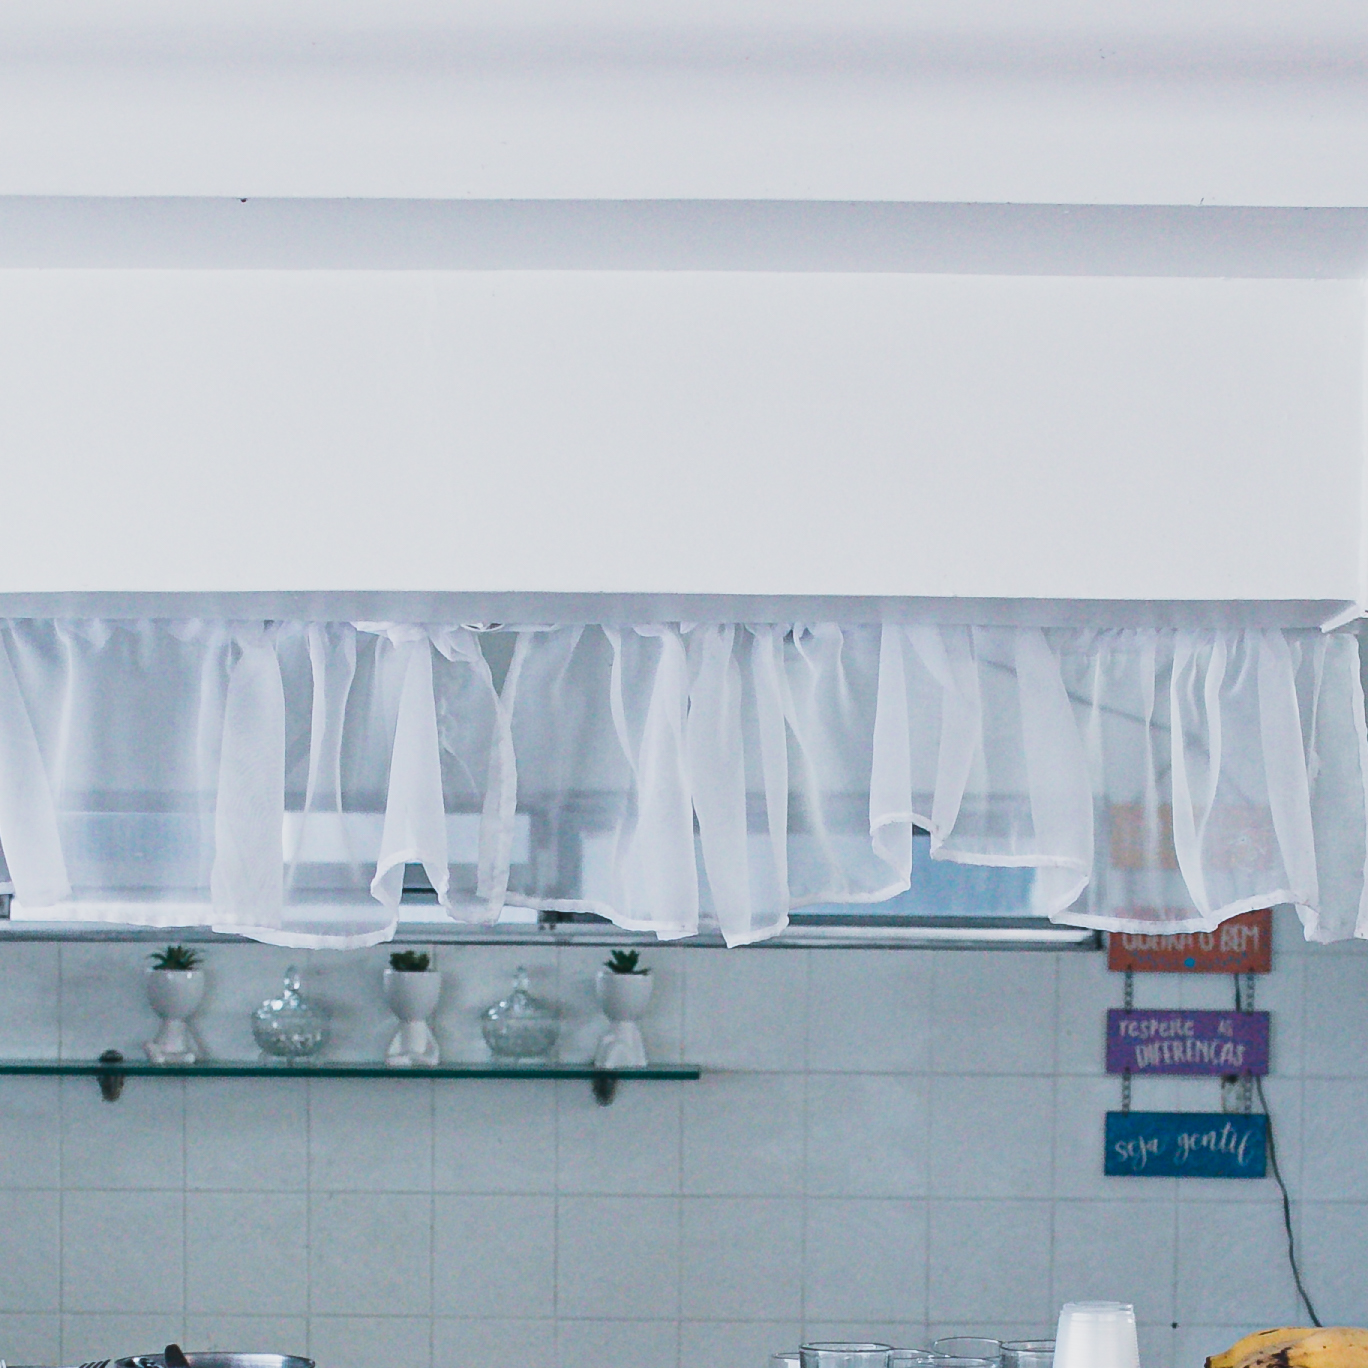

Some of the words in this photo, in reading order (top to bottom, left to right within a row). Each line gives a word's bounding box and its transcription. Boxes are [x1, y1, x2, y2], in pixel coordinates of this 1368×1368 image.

[1219, 924, 1260, 953] BEM
[1113, 1136, 1160, 1171] seja
[1173, 1121, 1253, 1167] gentil
